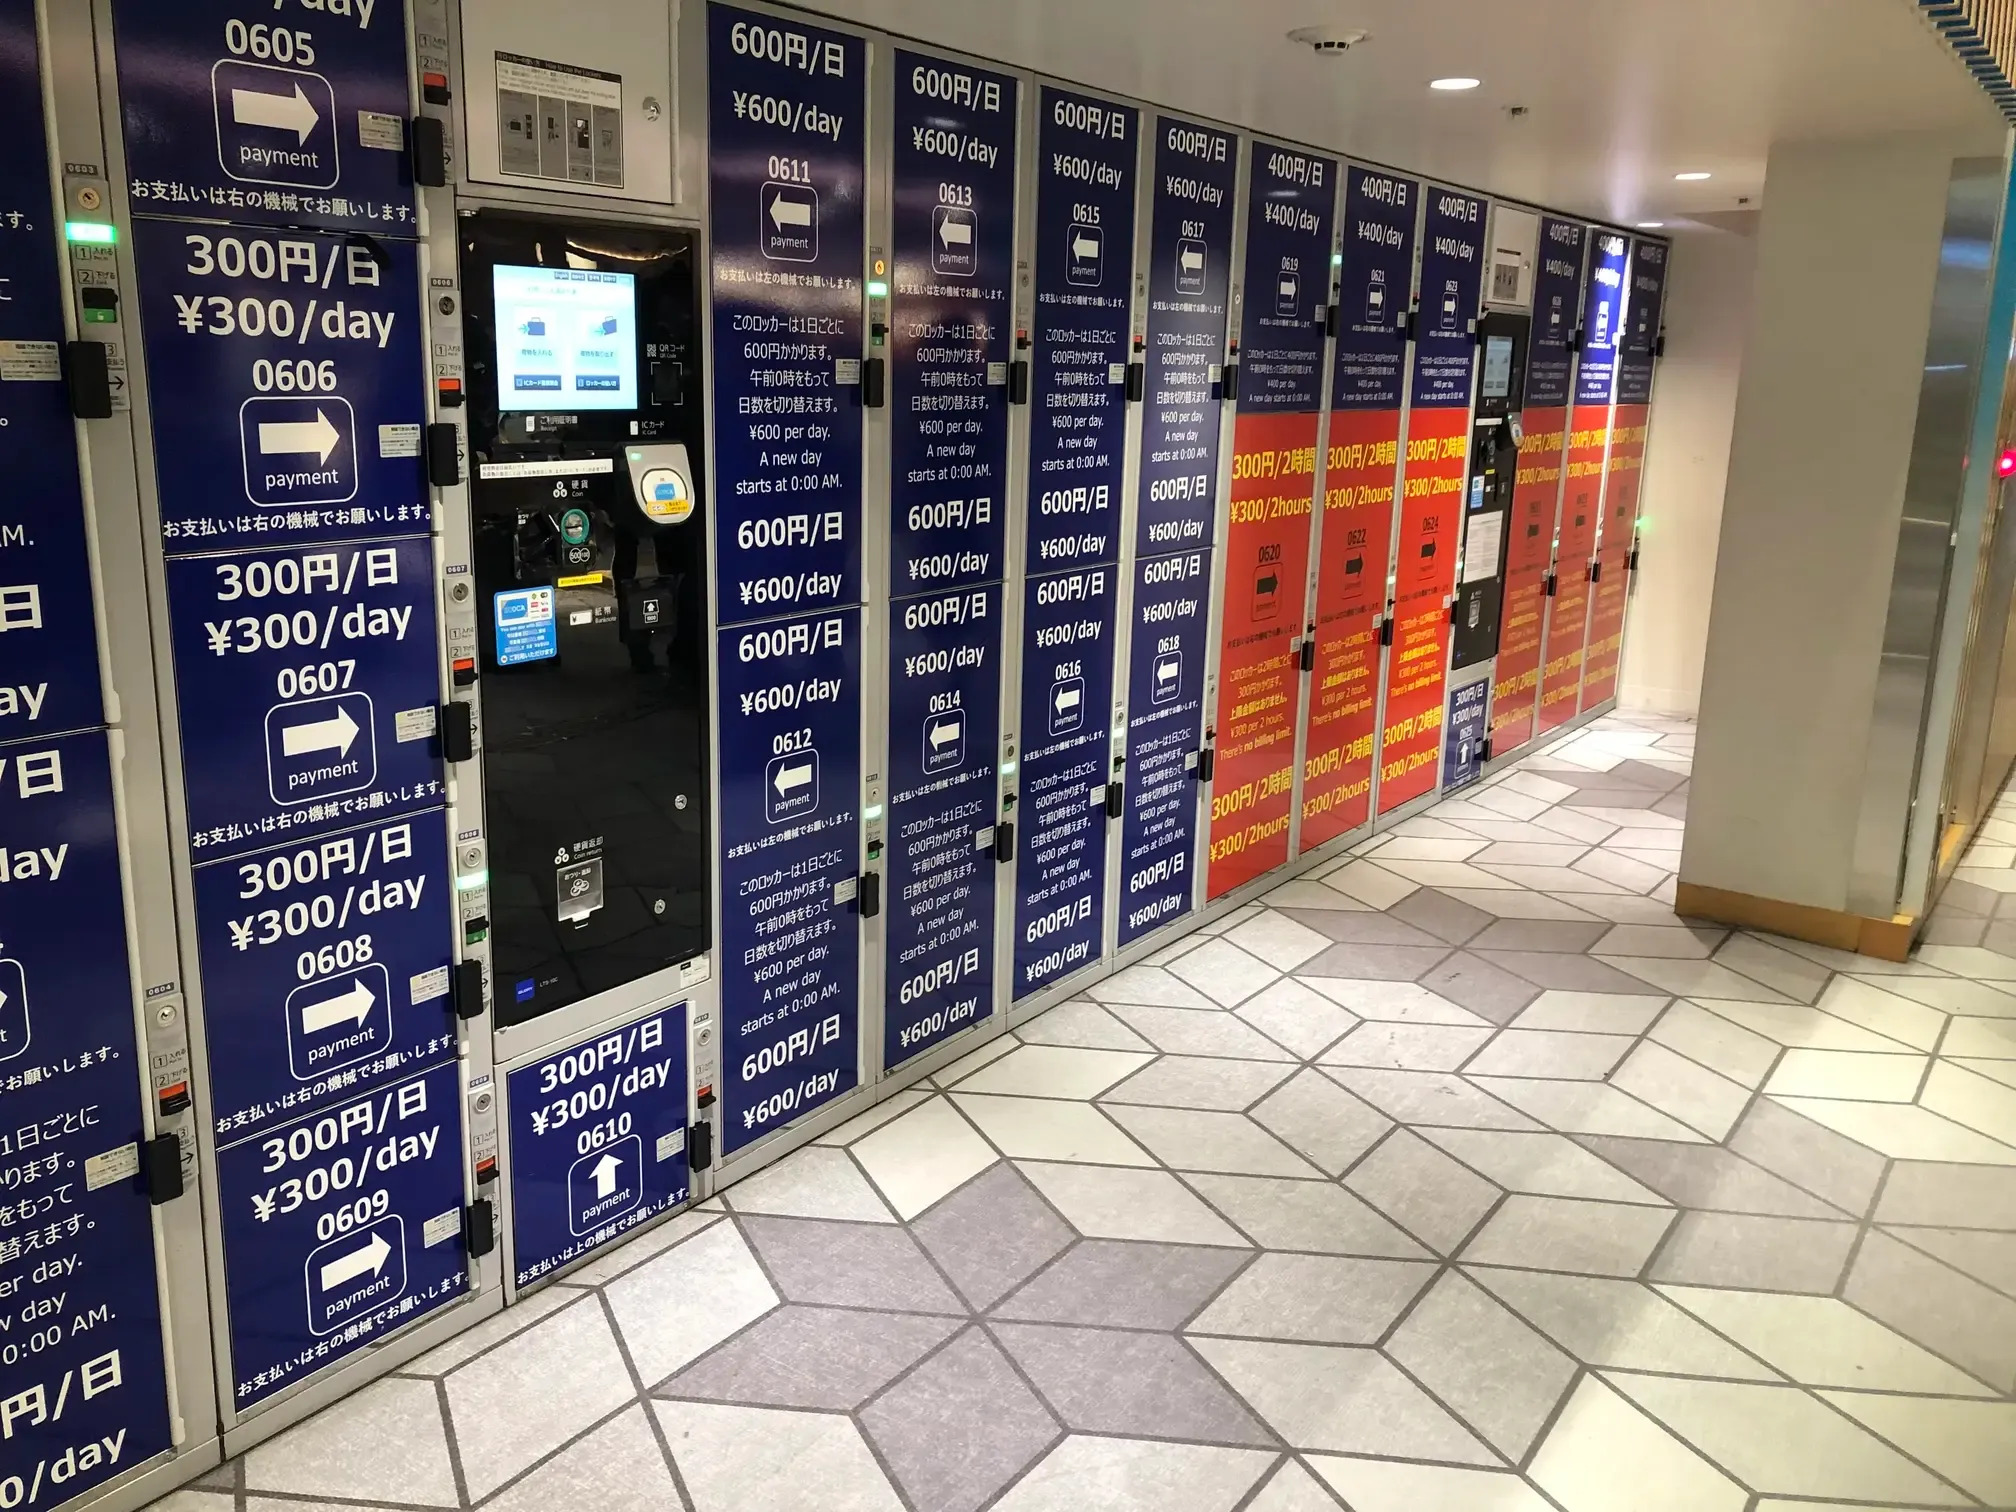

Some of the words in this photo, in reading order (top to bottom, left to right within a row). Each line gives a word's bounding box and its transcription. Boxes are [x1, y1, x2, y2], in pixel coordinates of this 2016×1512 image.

[225, 19, 315, 66] 0605
[731, 22, 844, 78] 600円/日
[912, 66, 1000, 112] 600円/日
[733, 90, 842, 141] ¥600/day
[1054, 100, 1125, 140] 600円/日
[240, 144, 319, 169] payment
[913, 126, 998, 169] ¥600/day
[1168, 128, 1227, 163] 600円/日
[768, 156, 810, 183] 0611
[1053, 153, 1122, 191] ¥600/day
[1268, 153, 1323, 187] 400円/日
[131, 178, 418, 225] お支払いは右の機械でお願いします。
[939, 182, 972, 206] 0613
[1167, 175, 1223, 208] ¥600/day
[1361, 176, 1407, 207] 400円/日
[1073, 203, 1100, 224] 0615
[1265, 202, 1320, 236] ¥400/day
[1438, 196, 1478, 223] 400円/日
[771, 235, 808, 249] payment
[1182, 220, 1205, 238] 0617
[1358, 220, 1403, 250] ¥400/day
[185, 234, 381, 288] 300円/日
[1281, 256, 1299, 271] 0619
[1435, 237, 1475, 262] ¥400/day
[720, 269, 855, 290] お支払いは左の機械でお願いします。
[173, 294, 395, 348] ¥300/day
[733, 314, 844, 335] このロッカーは1日ごとに
[744, 343, 832, 361] 600円かかります。
[252, 359, 337, 392] 0606
[750, 369, 830, 387] 午前0時をもって
[739, 396, 838, 414] 日数を切り替えます。
[749, 425, 780, 440] ¥600
[785, 427, 804, 443] per
[807, 424, 831, 440] day.
[1406, 435, 1467, 462] 300円/2時間
[760, 452, 769, 467] A
[772, 455, 797, 466] new
[801, 451, 822, 467] day
[1232, 447, 1317, 480] 300円/2時間
[1326, 440, 1397, 471] 300円/2時間
[265, 469, 339, 491] payment
[736, 479, 771, 495] starts
[775, 478, 787, 491] at
[791, 475, 818, 490] 0:00
[822, 474, 843, 488] AM.
[1151, 474, 1207, 502] 600円/日
[1324, 485, 1394, 510] ¥300/2hours
[1404, 476, 1463, 498] ¥300/2hours
[908, 497, 991, 531] 600円/日
[1041, 485, 1109, 515] 600円/日
[1230, 496, 1313, 524] ¥300/2hours
[163, 504, 432, 538] お支払いは右の機械でお願いします。
[738, 512, 843, 550] 600円/日
[1149, 519, 1204, 542] ¥600/day
[1041, 534, 1106, 560] ¥600/day
[1258, 543, 1281, 563] 0620
[215, 548, 399, 601] 300円/日
[909, 551, 989, 581] ¥600/day
[1144, 554, 1201, 584] 600円/日
[740, 572, 842, 605] ¥600/day
[1037, 571, 1105, 606] 600円/日
[905, 592, 987, 630] 600円/日
[1143, 598, 1198, 624] ¥600/day
[204, 603, 413, 656] ¥300/day
[739, 618, 843, 663] 600円/日
[1037, 620, 1102, 648] ¥600/day
[1158, 635, 1180, 653] 0618
[277, 659, 356, 698] 0607
[905, 646, 985, 678] ¥600/day
[1055, 659, 1081, 680] 0616
[740, 678, 841, 716] ¥600/day
[929, 690, 961, 714] 0614
[773, 728, 812, 755] 0612
[1382, 704, 1443, 748] 300円/2時間
[288, 759, 358, 789] payment
[1304, 733, 1373, 782] 300円/2時間
[1380, 746, 1439, 783] ¥300/2hours
[775, 793, 810, 814] payment
[1211, 765, 1294, 821] 300円/2時間
[1302, 777, 1371, 820] ¥300/2hours
[192, 780, 447, 848] お支払いは右の機械でお願いします。
[728, 812, 853, 859] お支払いは左の機械でお願いします。
[1209, 813, 1290, 863] ¥300/2hours
[238, 824, 412, 899] 300円/日
[1130, 852, 1185, 893] 600円/日
[227, 875, 426, 951] ¥300/day
[1027, 895, 1091, 943] 600円/日
[1129, 893, 1182, 929] ¥600/day
[296, 934, 373, 980] 0608
[1026, 940, 1089, 982] ¥600/day
[900, 947, 979, 1005] 600円/日
[900, 996, 978, 1048] ¥600/day
[308, 1027, 375, 1063] payment
[539, 1018, 662, 1093] 300円/日
[742, 1014, 840, 1081] 600円/日
[216, 1033, 457, 1133] お支払いは右の機械でお願いします。
[530, 1058, 671, 1136] ¥300/day
[742, 1068, 839, 1130] ¥600/day
[262, 1080, 427, 1173] 300円/日
[577, 1113, 631, 1154] 0610
[250, 1126, 440, 1222] ¥300/day
[316, 1188, 389, 1240] 0609
[582, 1187, 630, 1222] payment
[517, 1187, 690, 1284] お支払いは上の機械でお願いします。
[21, 1292, 66, 1322] day
[325, 1276, 391, 1319] payment
[2, 1326, 62, 1366] 0:00
[71, 1304, 116, 1336] AM.
[237, 1271, 468, 1397] お支払いは右の機械でお願いします。
